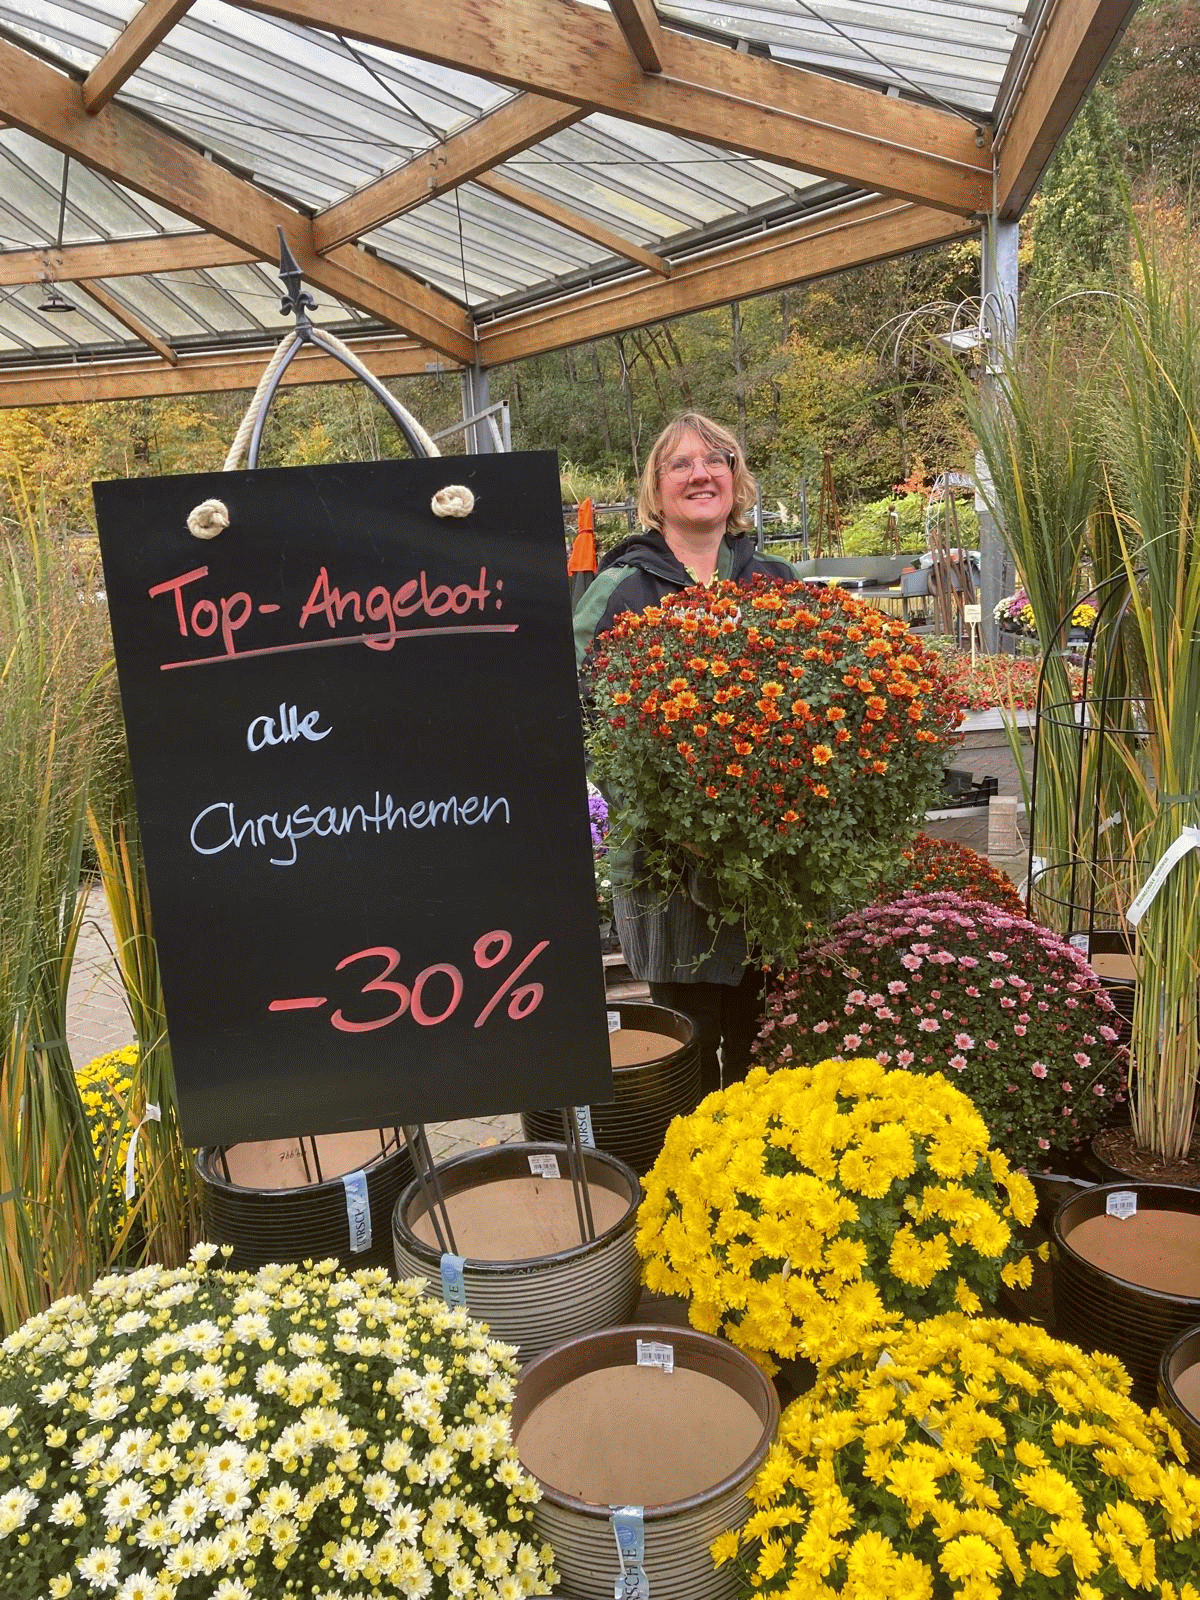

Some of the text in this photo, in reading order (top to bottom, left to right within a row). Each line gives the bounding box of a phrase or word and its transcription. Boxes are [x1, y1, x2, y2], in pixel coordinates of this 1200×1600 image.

[299, 566, 504, 651] Angebot:
[246, 702, 333, 753] alle
[190, 790, 510, 866] Chrysanthemen
